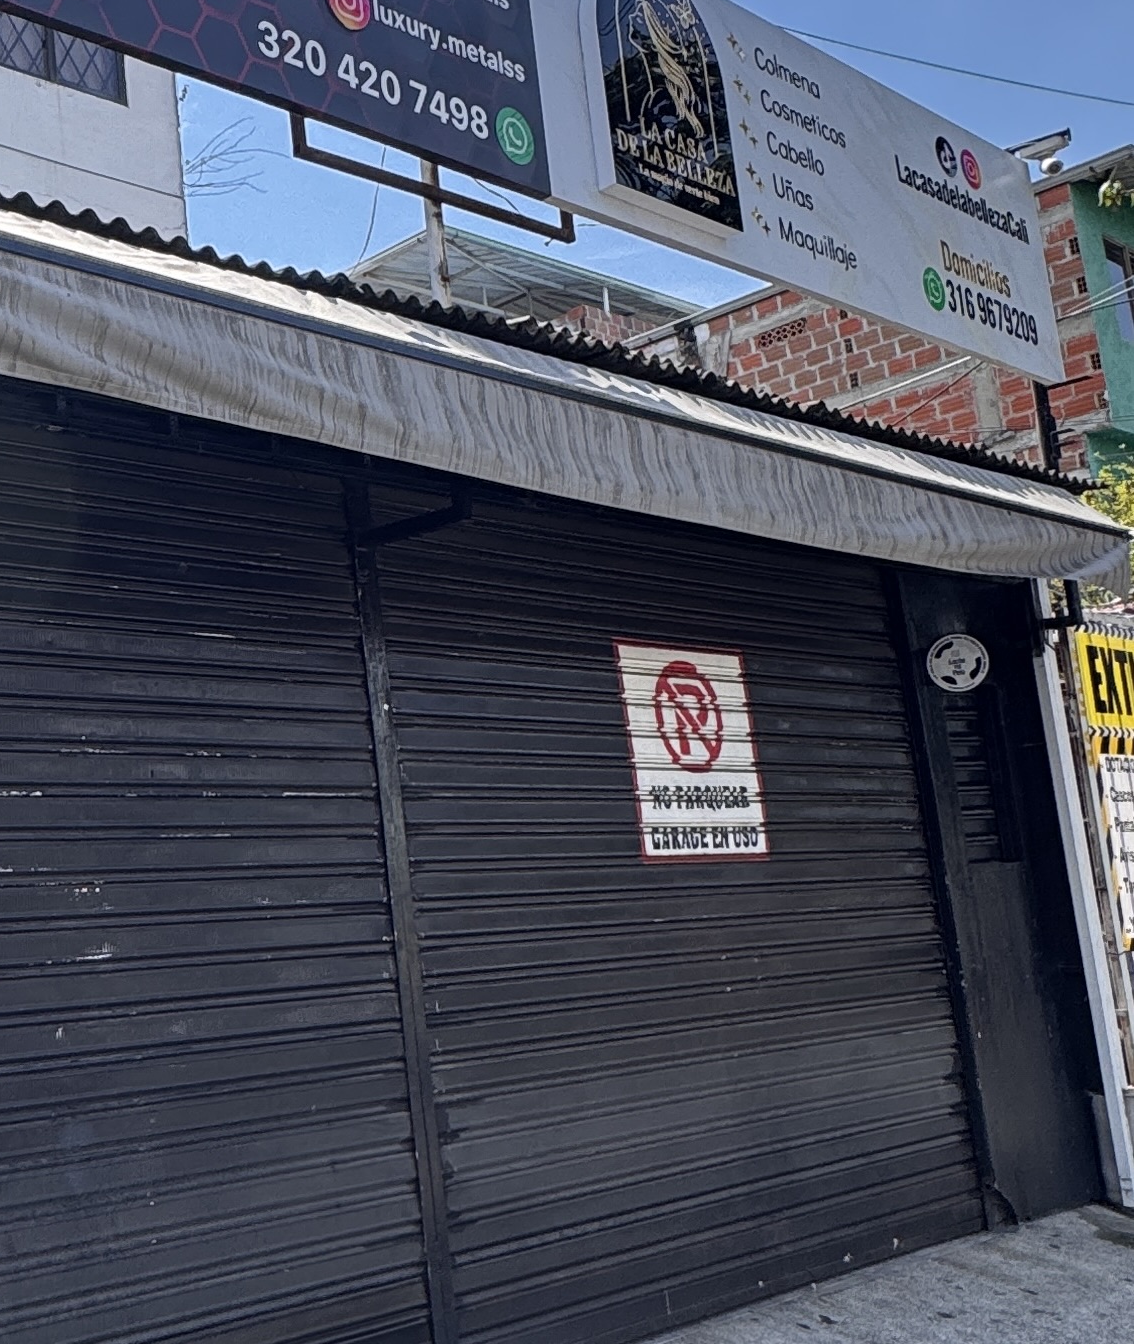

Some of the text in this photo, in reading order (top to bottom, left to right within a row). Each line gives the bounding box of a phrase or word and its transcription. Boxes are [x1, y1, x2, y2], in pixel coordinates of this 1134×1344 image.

[257, 21, 489, 139] 320 420 7498
[754, 47, 821, 99] Colmena
[639, 116, 709, 164] LA CASA
[760, 89, 846, 149] Cosmeticos
[615, 128, 736, 197] DE LA BELLEZA
[766, 130, 825, 177] Cabello
[772, 172, 814, 211] Uñas
[894, 154, 1030, 246] LacasadelabellezaCali
[778, 216, 858, 272] Maquillaje
[939, 239, 1011, 299] Domicilios
[945, 279, 1039, 346] 316 9679209
[650, 785, 750, 812] NO PARQUEAR
[712, 826, 729, 849] EN
[733, 826, 759, 848] USO
